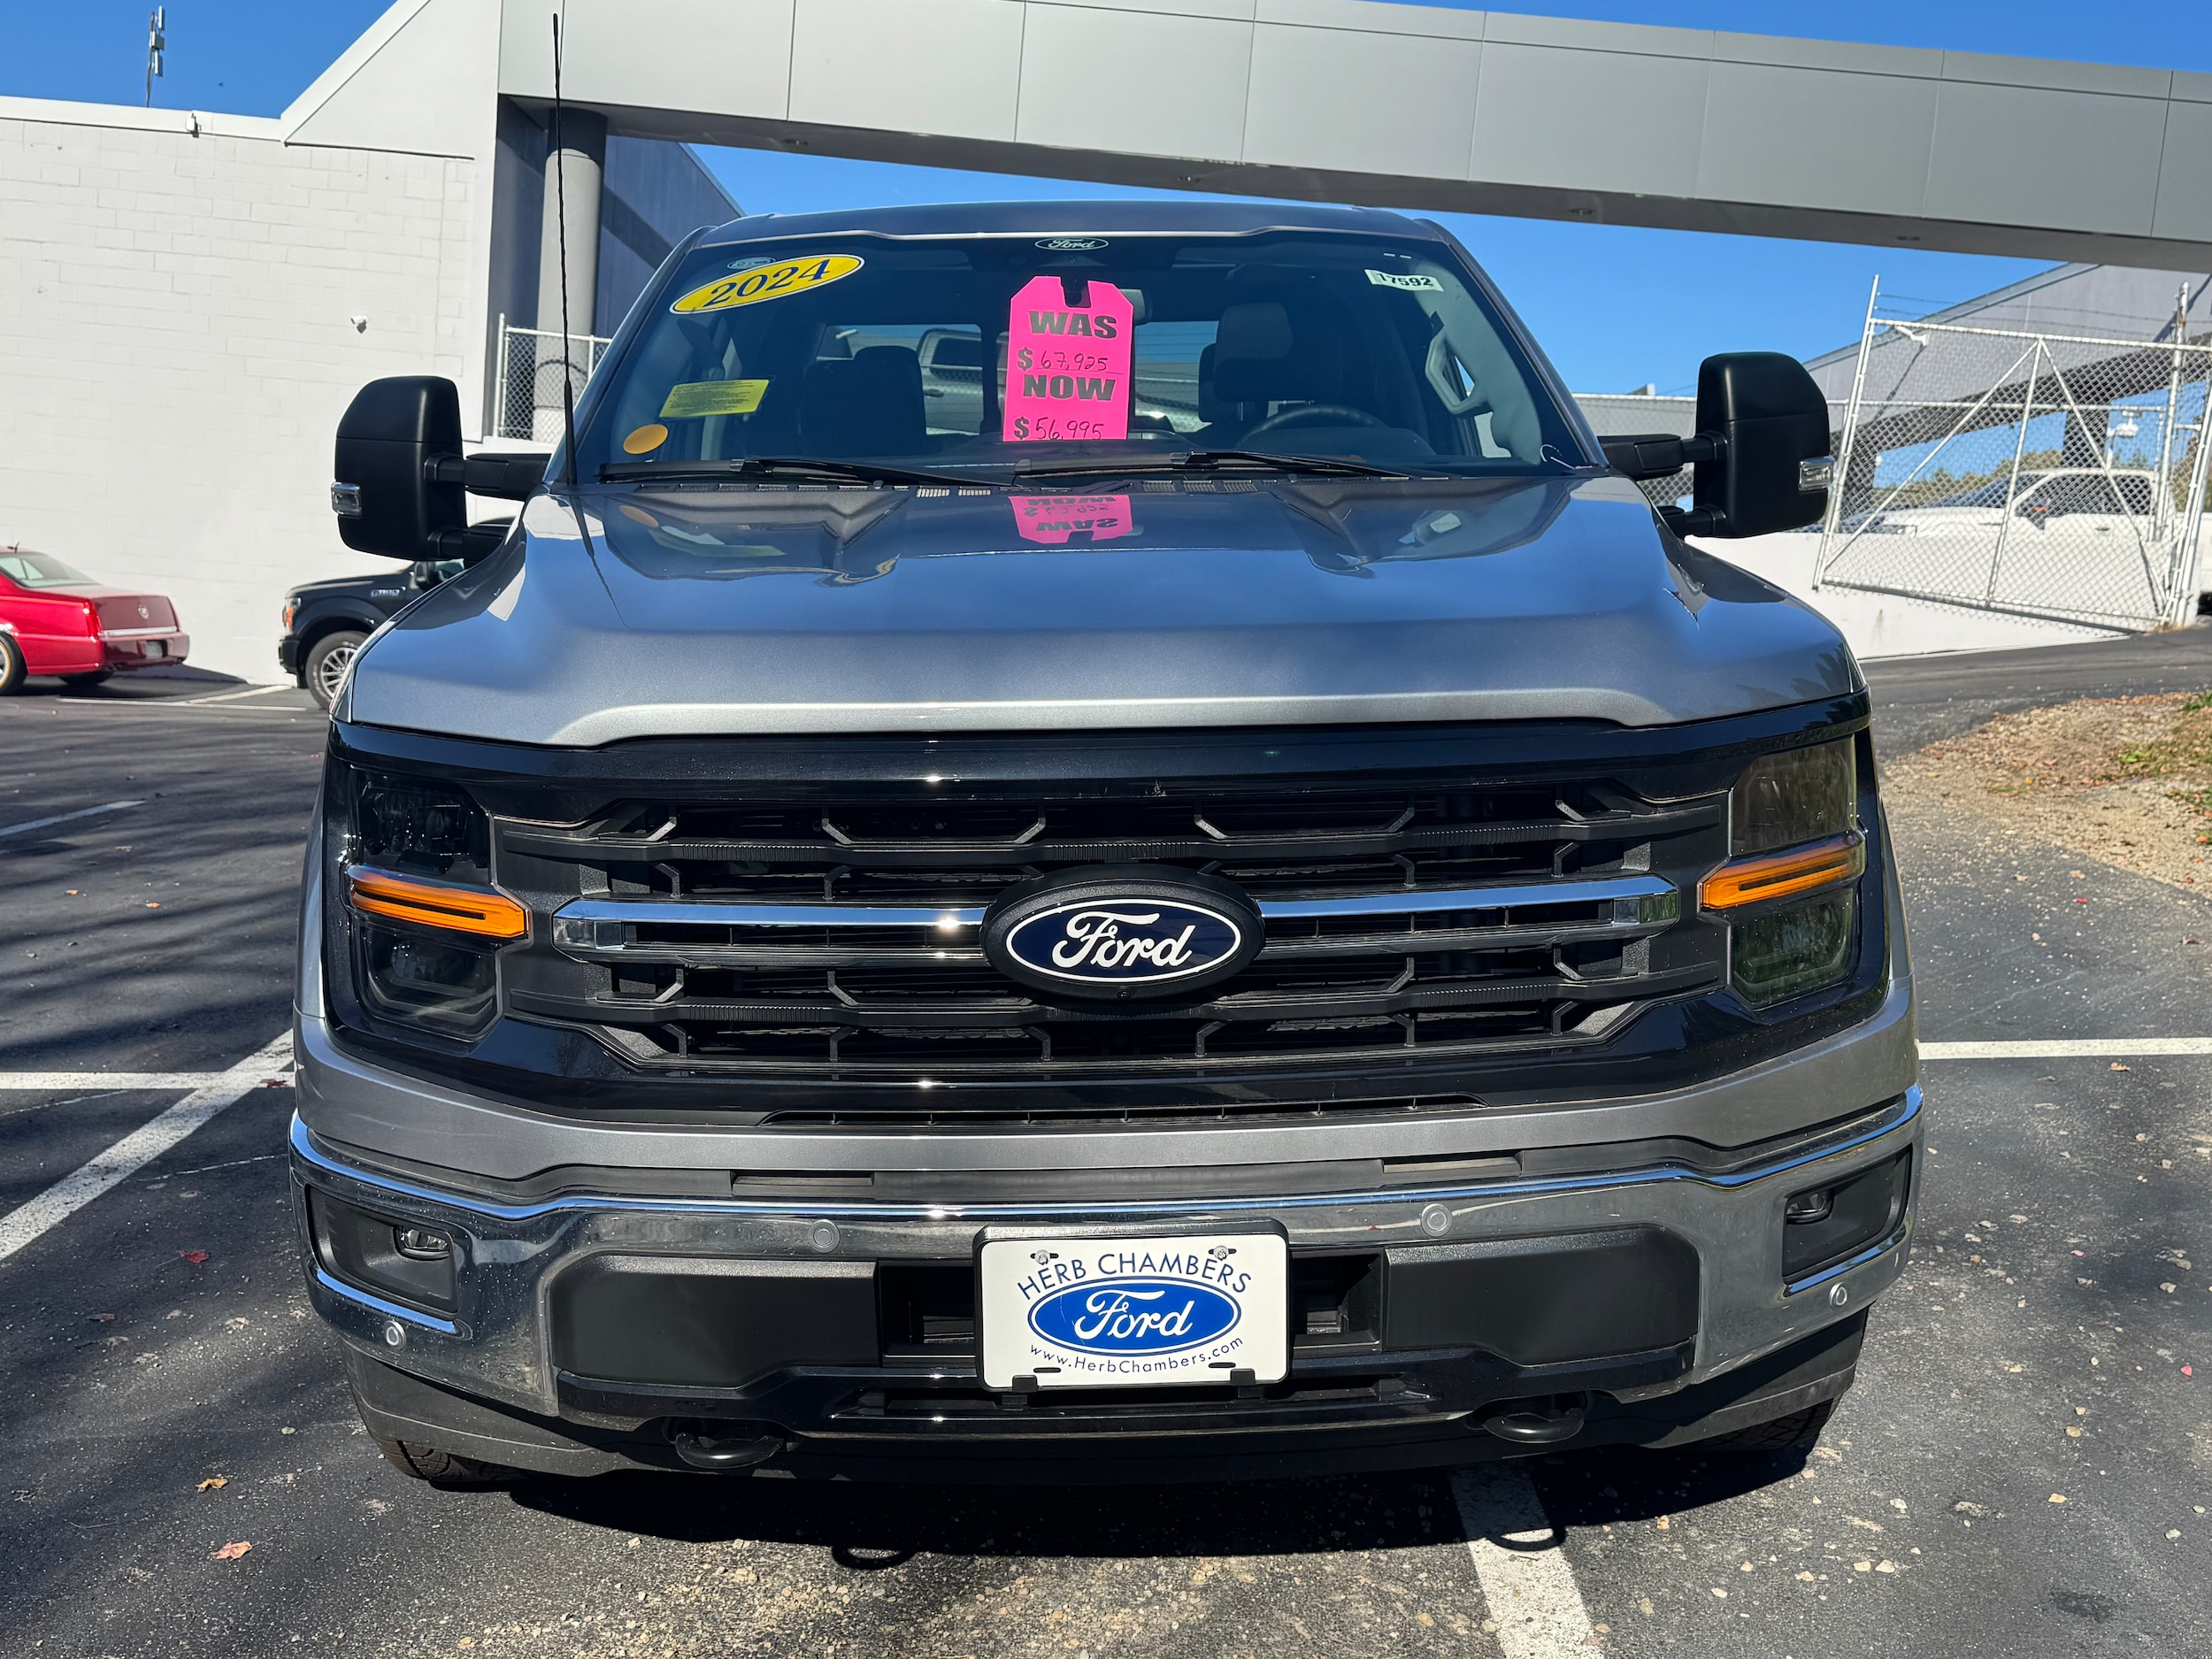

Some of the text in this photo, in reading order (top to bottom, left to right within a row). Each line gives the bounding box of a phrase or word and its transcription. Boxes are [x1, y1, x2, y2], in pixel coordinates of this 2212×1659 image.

[1048, 238, 1095, 250] Ford
[703, 258, 831, 308] 2024
[1029, 311, 1118, 339] WAS
[1023, 374, 1116, 402] NOW
[1051, 911, 1196, 968] Ford
[1017, 1252, 1252, 1301] HERB CHAMBERS
[1074, 1289, 1195, 1340] Ford
[1030, 1337, 1243, 1373] www.HerbChambers.com
